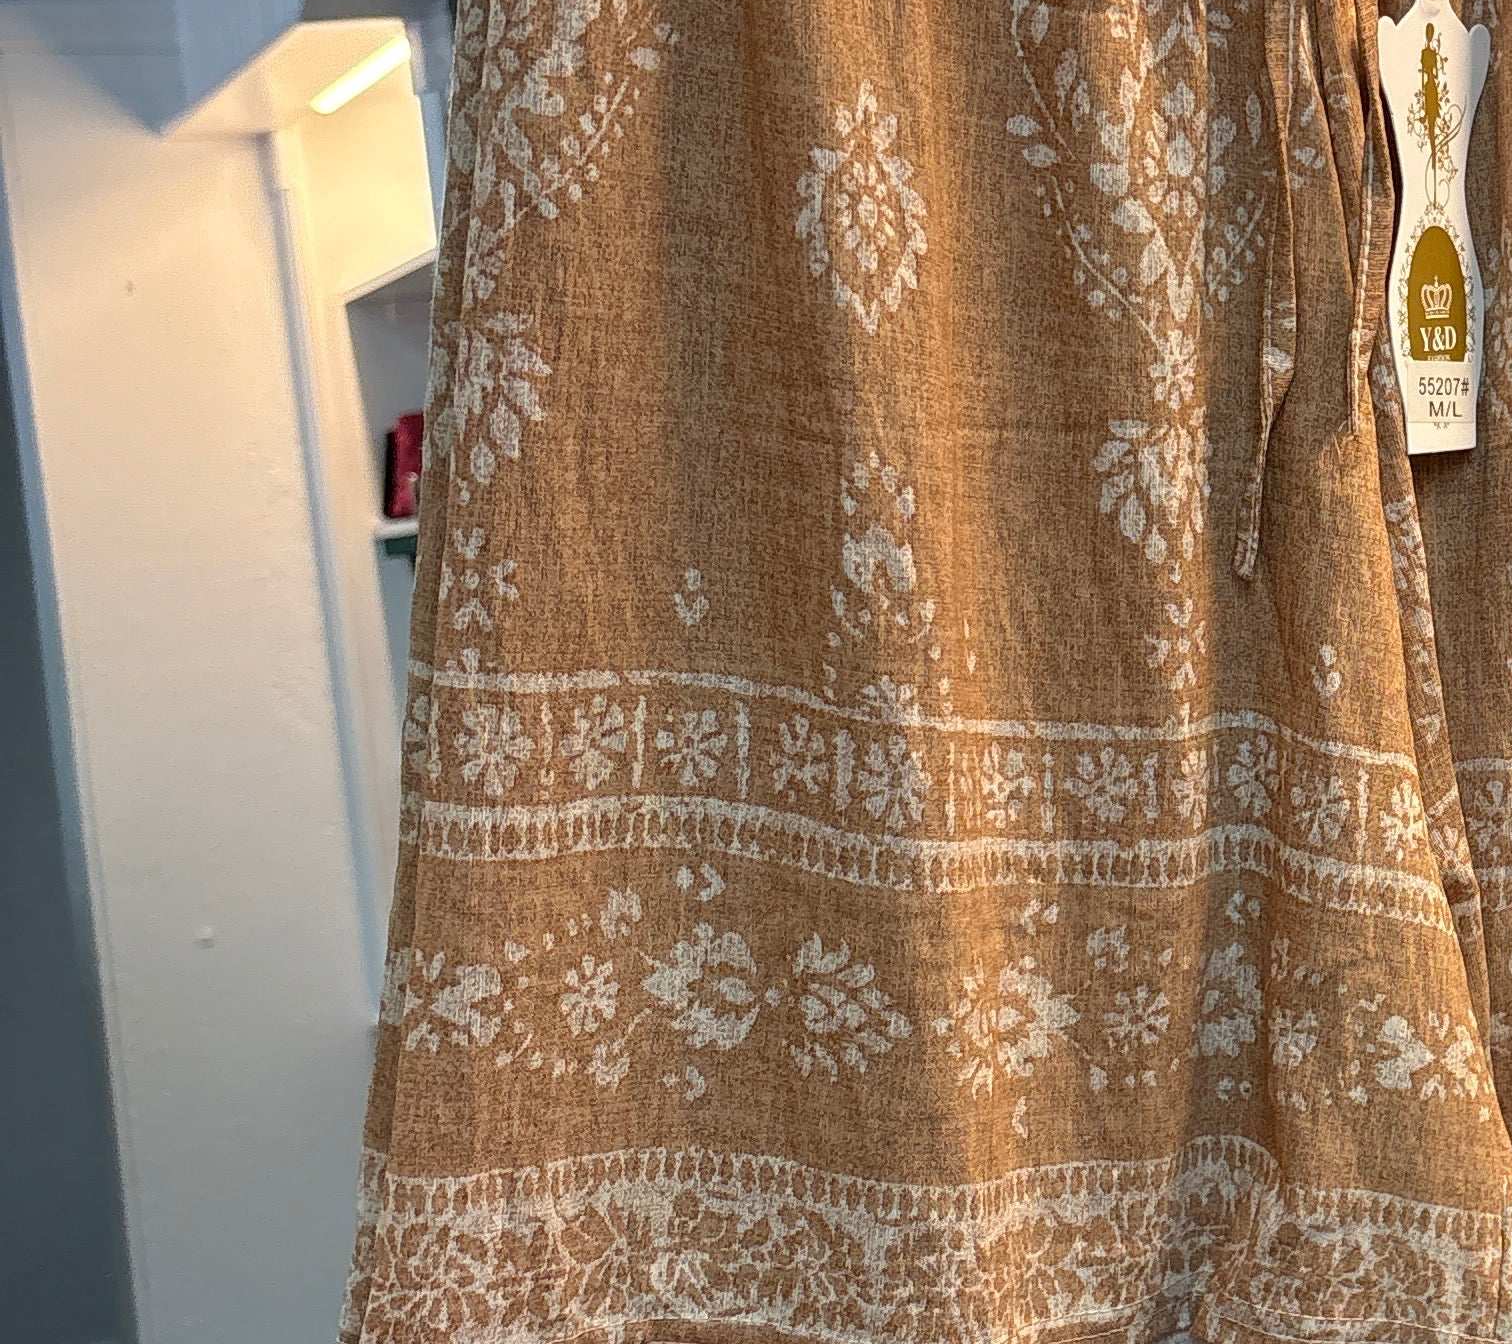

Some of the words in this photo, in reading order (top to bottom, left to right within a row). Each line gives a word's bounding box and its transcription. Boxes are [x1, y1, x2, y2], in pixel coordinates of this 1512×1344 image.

[1419, 325, 1457, 352] Y&D
[1418, 376, 1470, 396] 55207#
[1429, 401, 1463, 418] M/L
